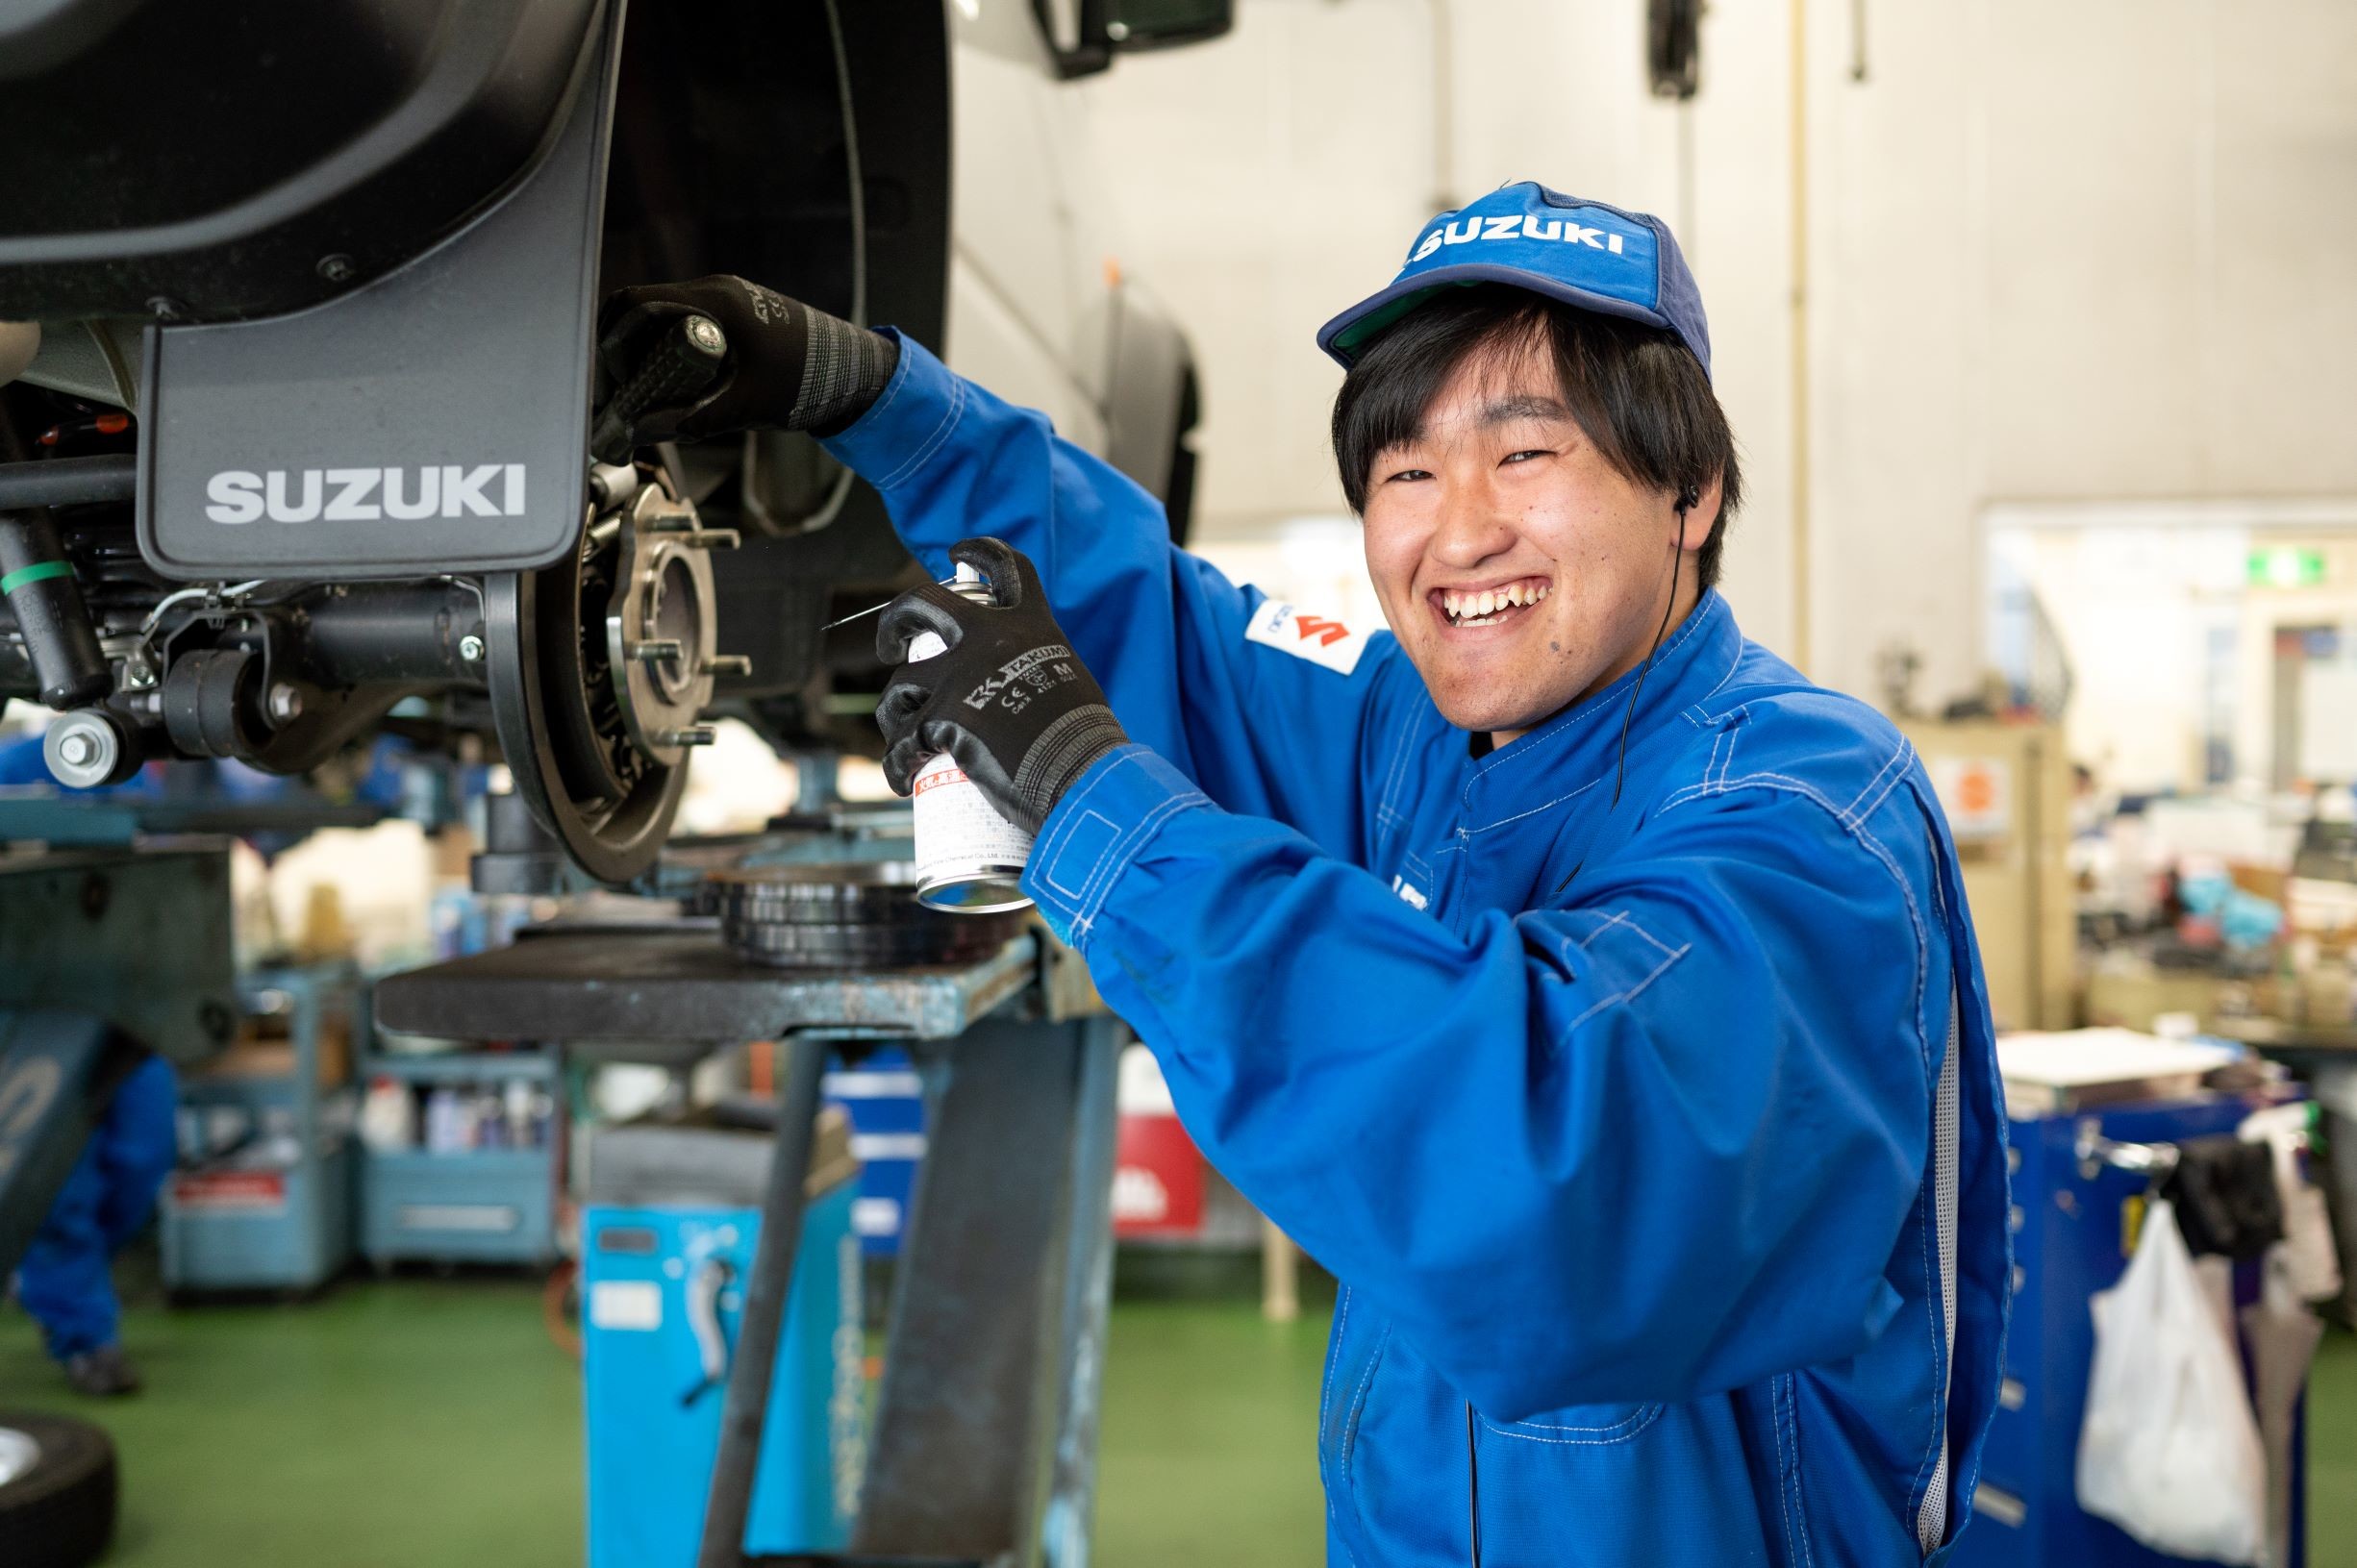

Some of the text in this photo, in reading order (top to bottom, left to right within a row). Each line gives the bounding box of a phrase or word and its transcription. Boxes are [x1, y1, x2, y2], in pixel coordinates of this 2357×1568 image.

[1413, 214, 1624, 262] SUZUKI
[205, 462, 526, 525] SUZUKI
[1053, 662, 1074, 675] M
[1001, 686, 1026, 708] CE
